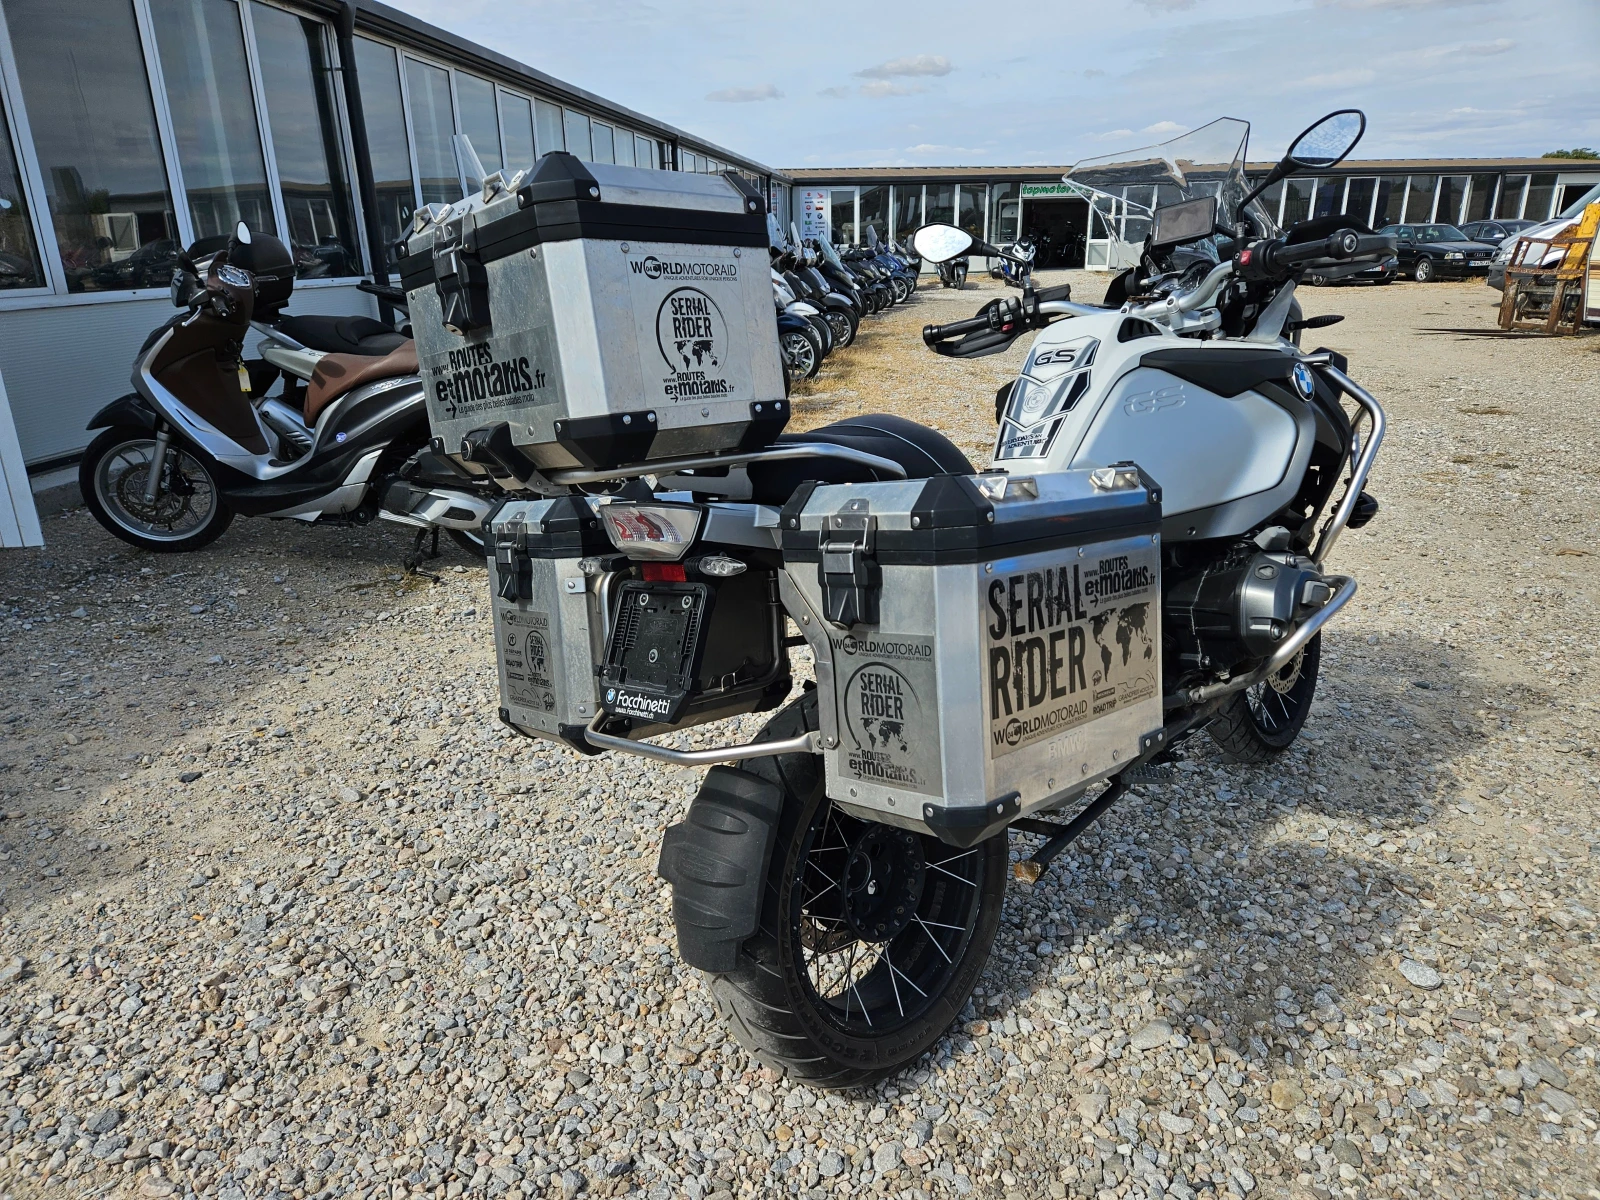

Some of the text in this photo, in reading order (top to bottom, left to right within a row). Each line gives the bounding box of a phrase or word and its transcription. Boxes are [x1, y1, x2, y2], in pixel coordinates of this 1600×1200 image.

[670, 297, 711, 316] SERIAL
[672, 316, 713, 339] RIDER
[1034, 349, 1077, 366] GS
[1123, 384, 1186, 417] GS
[988, 564, 1087, 641] SERIAL
[860, 672, 904, 696] SERIAL
[989, 625, 1087, 721] RIDER
[616, 689, 671, 715] Facchinetti
[860, 692, 904, 721] RIDER
